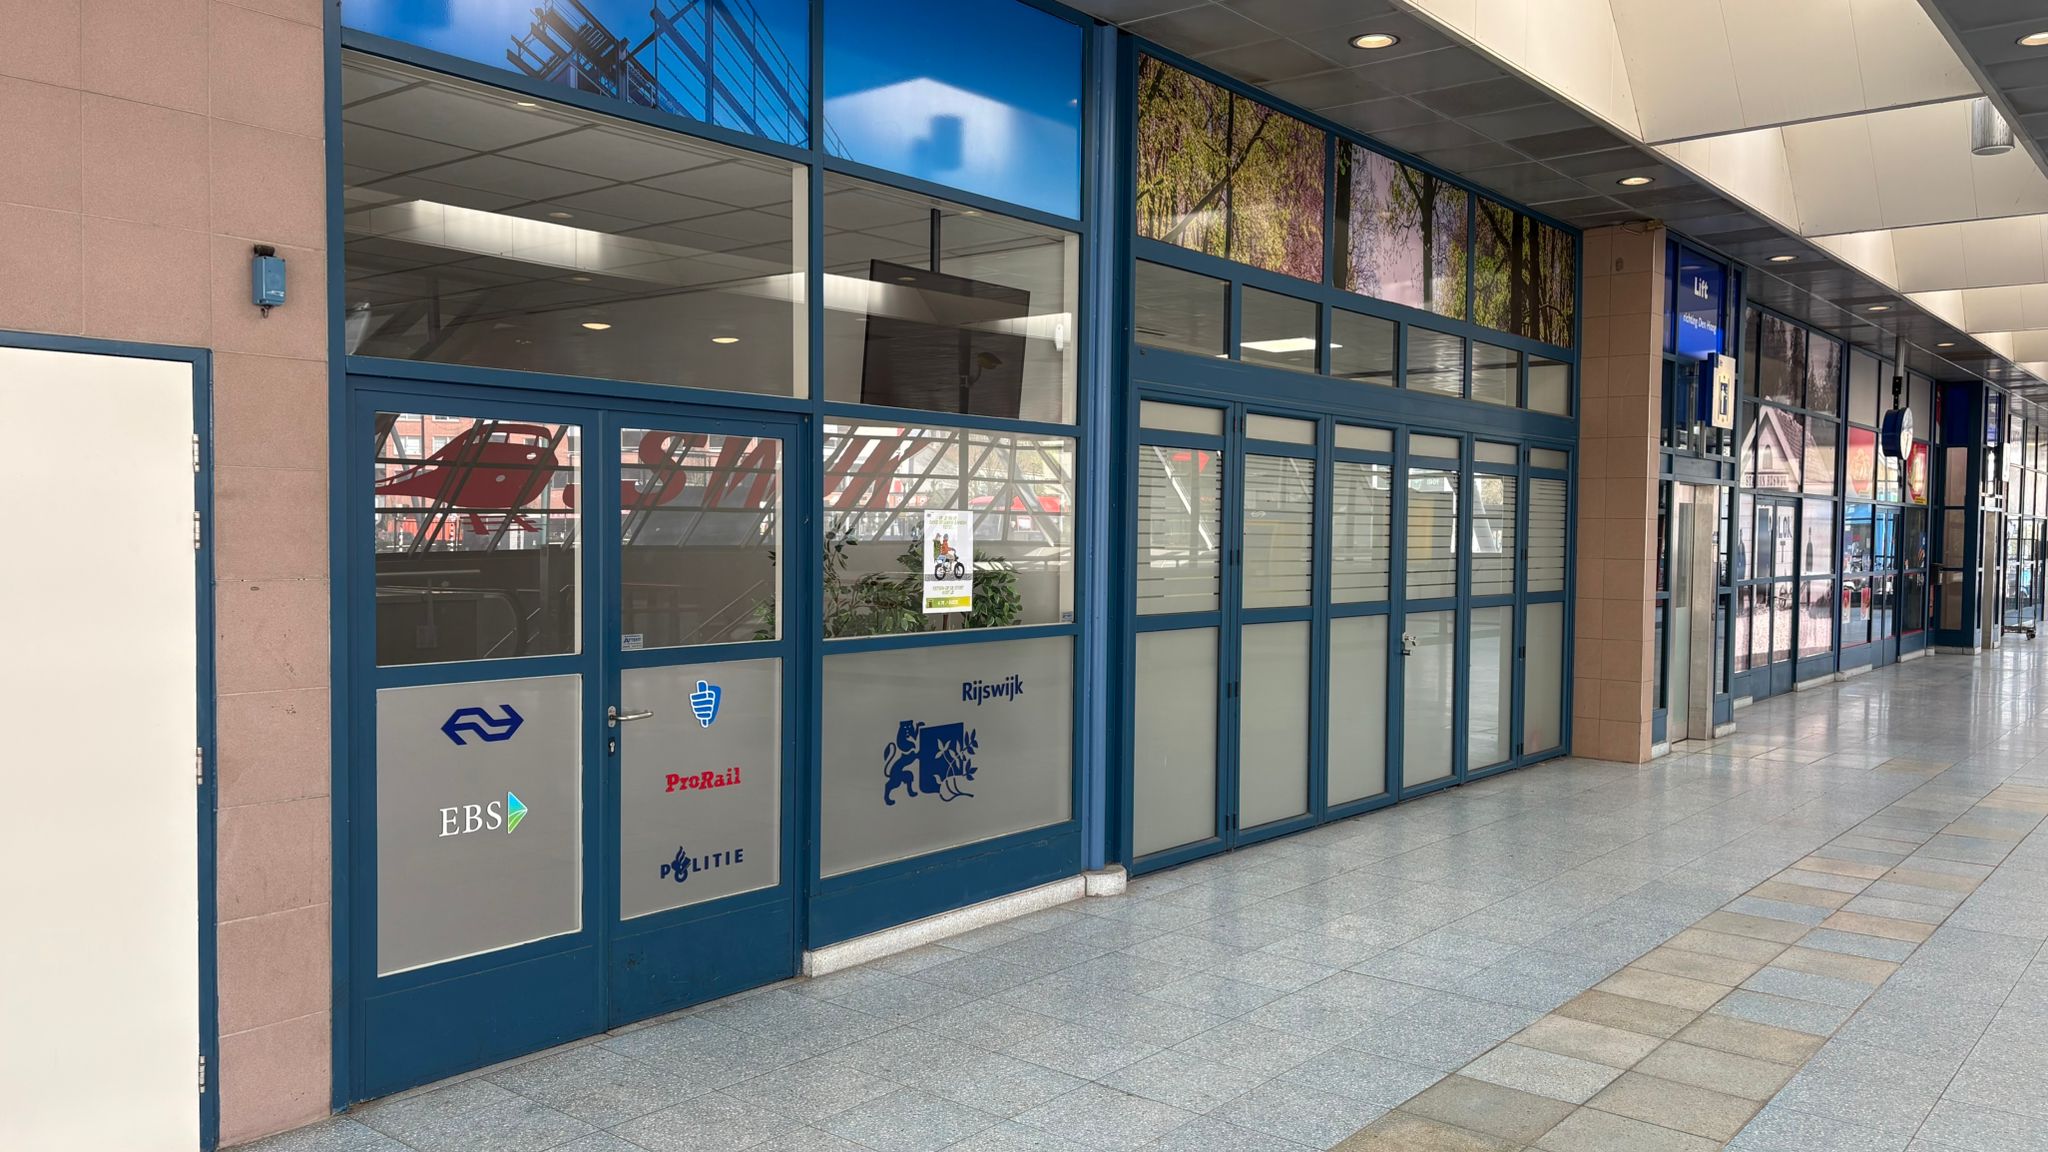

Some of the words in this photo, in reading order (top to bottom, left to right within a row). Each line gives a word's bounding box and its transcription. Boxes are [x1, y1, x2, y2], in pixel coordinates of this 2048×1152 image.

[1694, 276, 1708, 299] Lift
[1683, 312, 1698, 329] richting
[1698, 317, 1707, 329] Den
[962, 674, 1023, 706] Rijswijk
[664, 767, 741, 793] ProRail
[438, 800, 502, 838] EBS
[659, 846, 744, 883] POLITIE
